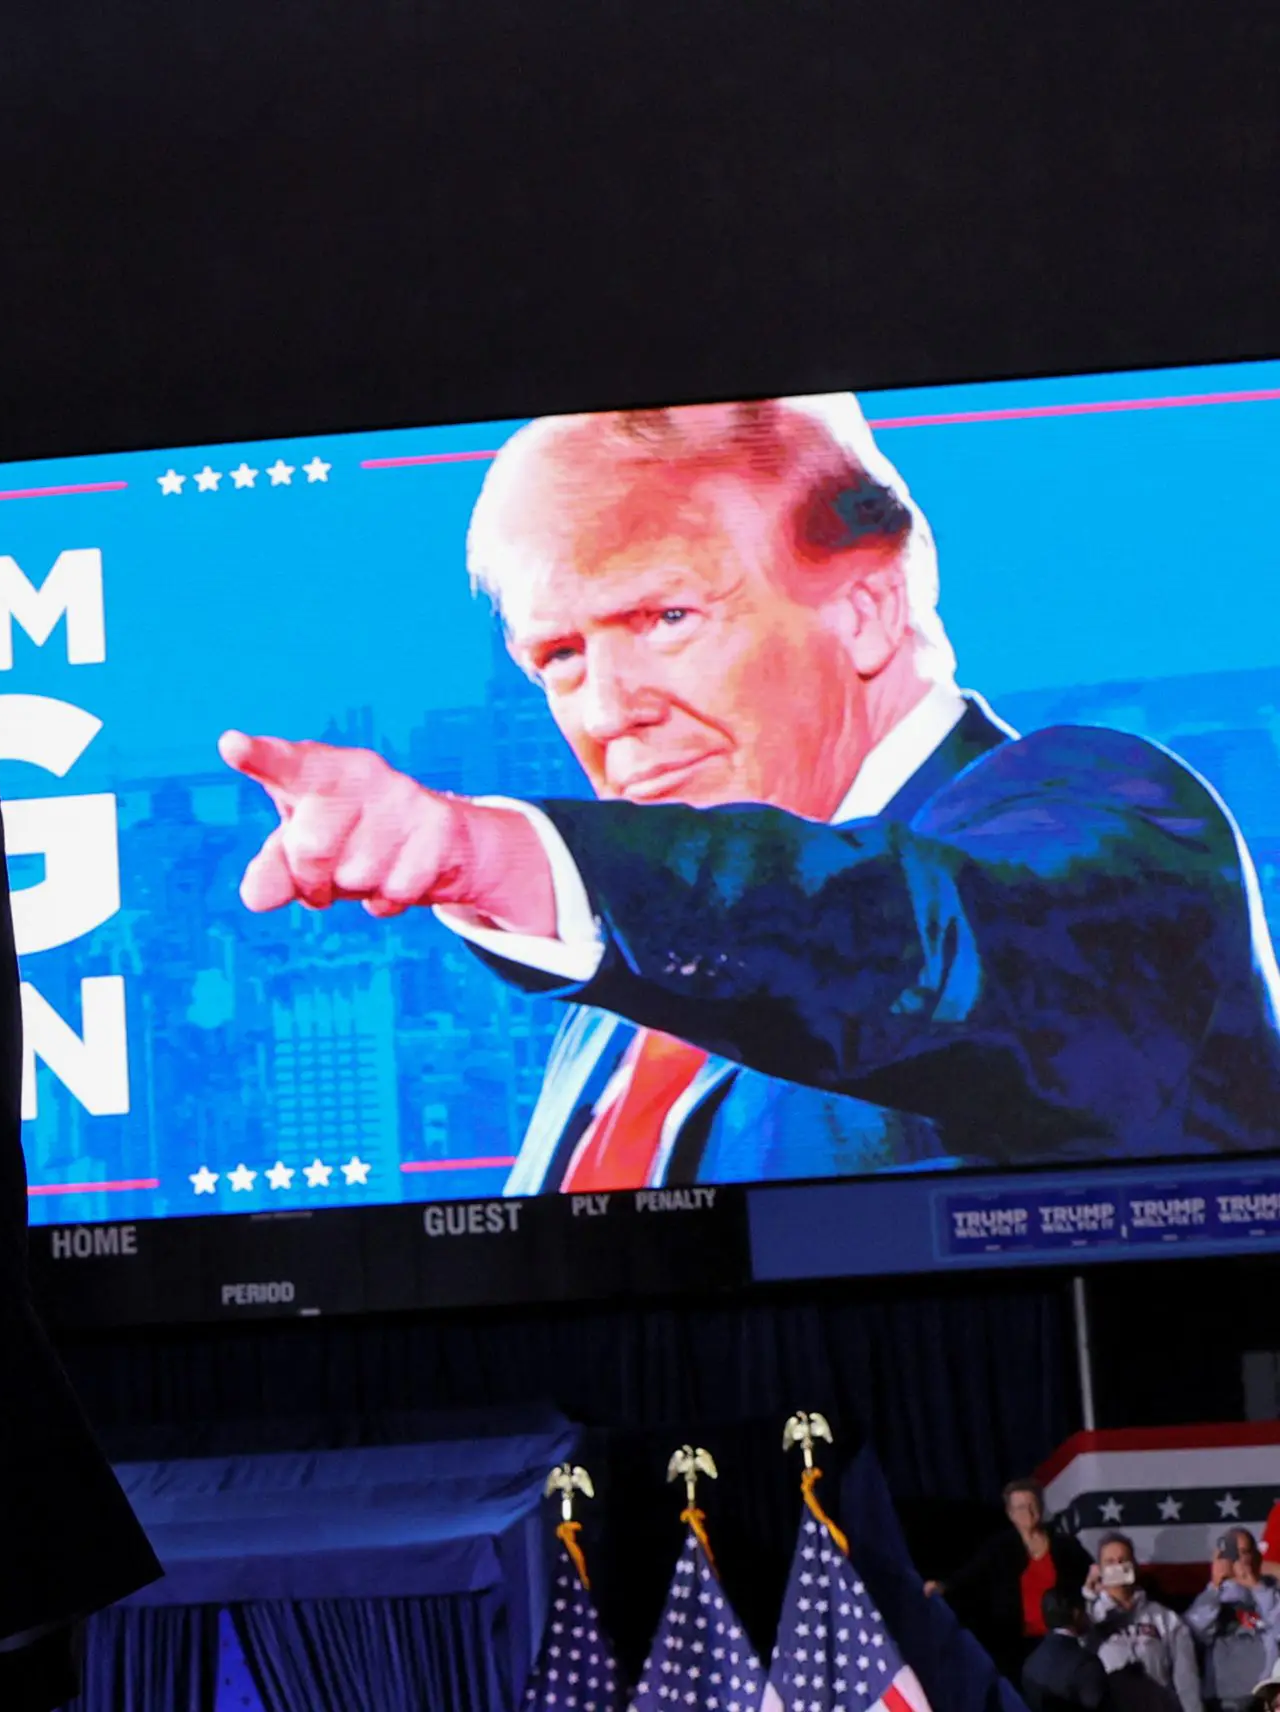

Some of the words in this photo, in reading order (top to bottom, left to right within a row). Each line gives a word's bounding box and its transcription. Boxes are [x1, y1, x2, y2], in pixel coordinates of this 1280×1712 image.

[572, 1194, 610, 1216] PLY
[636, 1187, 716, 1212] PENALTY
[1130, 1198, 1206, 1217] TRUMP
[1217, 1194, 1280, 1212] TRUM
[424, 1202, 522, 1236] GUEST
[953, 1209, 1027, 1227] TRUMP
[1039, 1203, 1115, 1222] TRUMP
[52, 1226, 138, 1259] HOME
[221, 1281, 295, 1306] PERIOD
